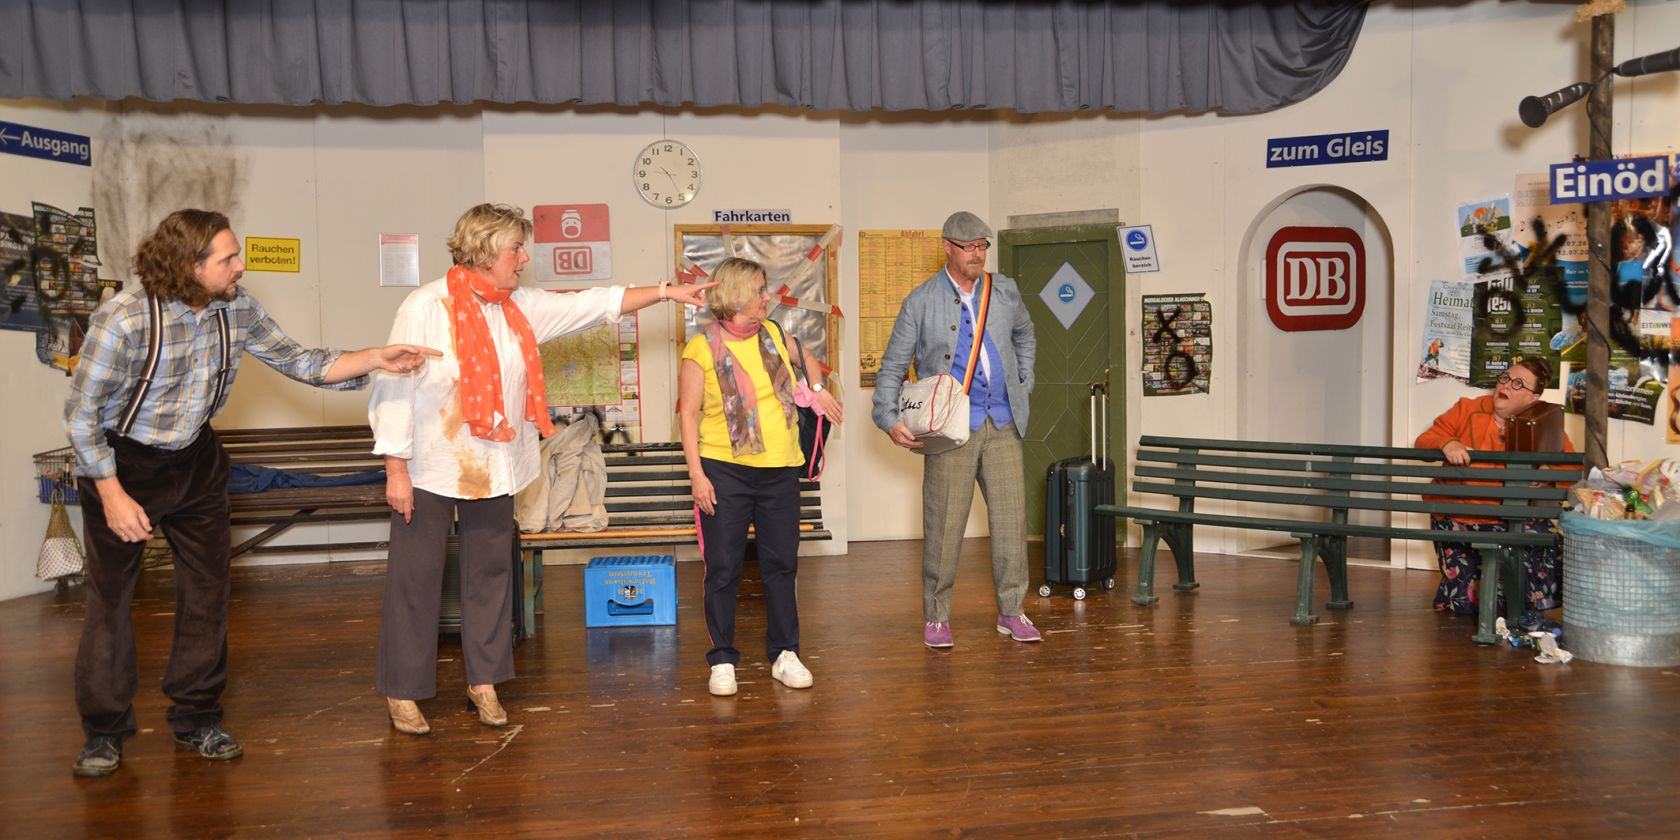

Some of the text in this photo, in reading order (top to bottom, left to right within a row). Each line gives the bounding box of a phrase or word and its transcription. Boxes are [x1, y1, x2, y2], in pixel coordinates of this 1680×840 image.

[21, 131, 89, 160] Ausgang
[664, 144, 673, 152] 12
[1270, 135, 1384, 161] zum Gleis
[652, 147, 660, 155] 11
[687, 158, 694, 166] 2
[639, 170, 646, 178] 9
[691, 170, 698, 178] 3
[1556, 159, 1665, 198] Einöd
[643, 183, 650, 191] 8
[687, 183, 694, 191] 4
[665, 196, 672, 204] 6
[678, 193, 685, 201] 5
[715, 210, 790, 222] Fahrkarten
[251, 243, 295, 254] Rauchen
[249, 255, 296, 265] verboten!
[1286, 257, 1346, 300] DB
